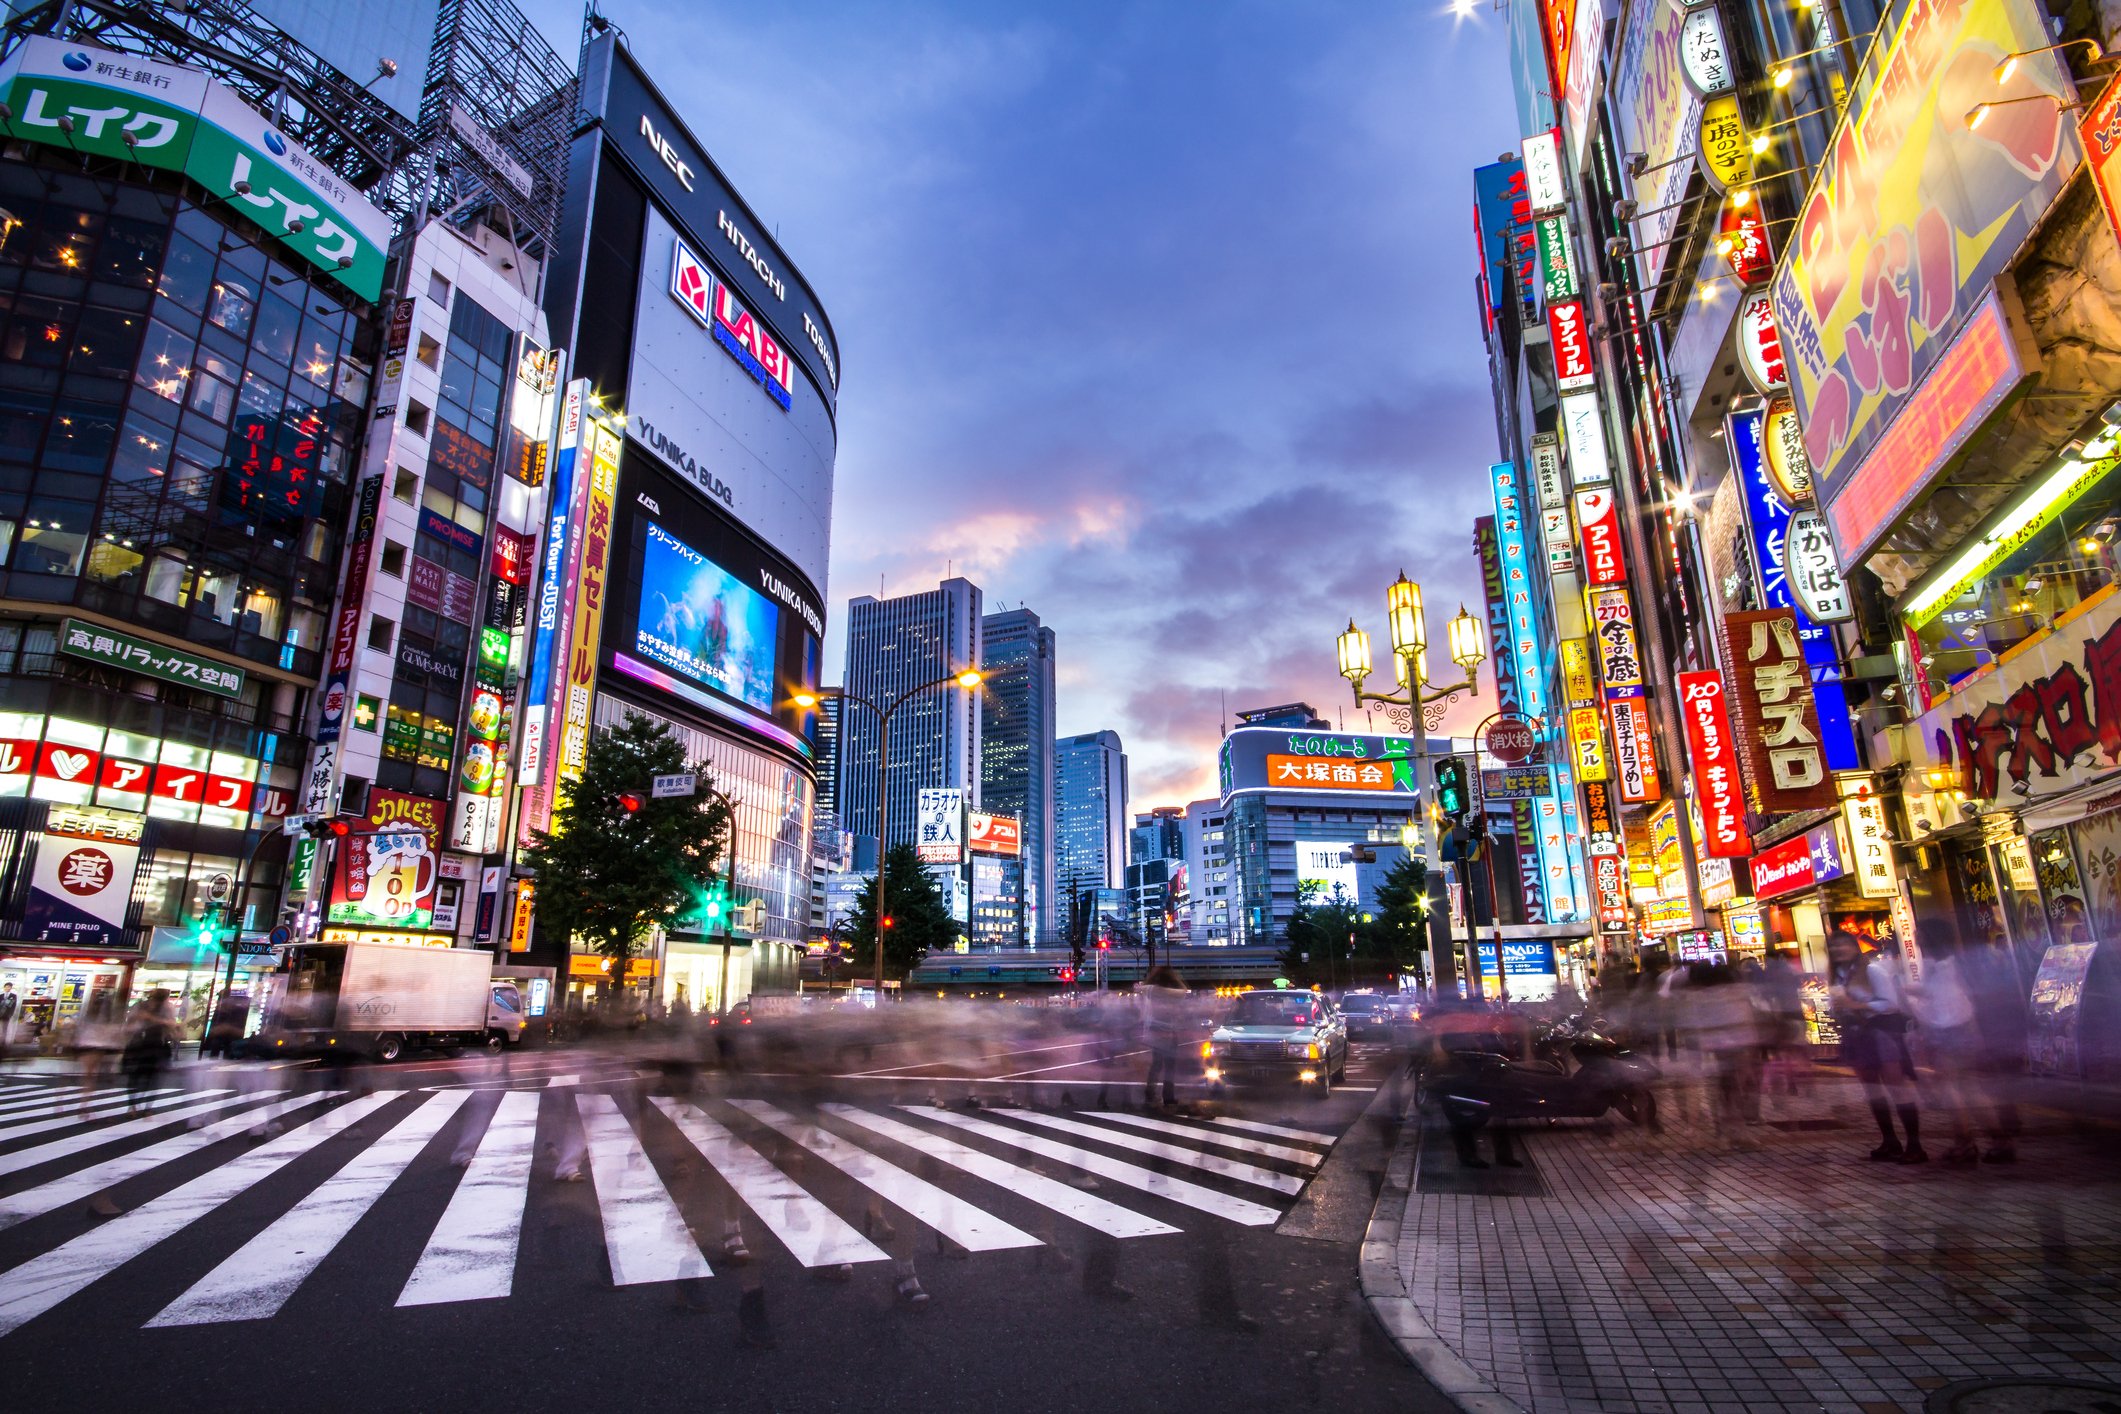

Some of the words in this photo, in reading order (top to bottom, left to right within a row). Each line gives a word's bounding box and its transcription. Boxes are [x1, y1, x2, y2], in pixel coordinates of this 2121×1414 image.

[1695, 30, 1724, 81] たぬき
[96, 60, 172, 91] 新生銀行
[1709, 80, 1726, 92] 5F
[22, 89, 180, 149] レイク
[640, 114, 695, 193] NEC
[1708, 122, 1745, 168] 虎の子
[289, 151, 348, 205] 新生銀行
[1728, 170, 1750, 183] 4F
[229, 151, 359, 263] レイク
[718, 208, 785, 302] HITACHI
[715, 281, 794, 396] LABI
[802, 311, 836, 391] TOSHIBA
[1558, 320, 1585, 378] アイフル
[567, 404, 579, 434] LABI
[435, 450, 489, 489] マッサージ
[637, 415, 698, 479] YUNIKA
[699, 466, 735, 509] BLDG.
[636, 491, 661, 516] LISA
[428, 516, 476, 550] PROMISE
[497, 534, 519, 552] FAST
[648, 524, 703, 567] クリープハイプ
[1590, 525, 1615, 570] アコム
[416, 565, 440, 581] FAST
[496, 545, 517, 563] NAIL
[1480, 524, 1504, 599] パチンコ
[1802, 531, 1841, 593] かっぱ
[415, 575, 438, 591] NAIL
[572, 493, 609, 685] 決算セール
[1598, 571, 1616, 582] 3F
[540, 580, 560, 631] JUST
[760, 567, 802, 615] YUNIKA
[801, 599, 824, 639] VISION
[1597, 607, 1629, 622] 270
[1818, 598, 1843, 613] B1
[336, 608, 358, 669] アイフル
[1489, 600, 1519, 708] エスパス
[1600, 620, 1639, 682] 金の蔵
[1799, 629, 1824, 640] 3F
[67, 629, 240, 692] 高興リラックス空間
[324, 691, 345, 712] 薬
[1617, 688, 1635, 698] 2F
[1747, 616, 1824, 790] パチスロ
[1490, 731, 1531, 750] 消火栓
[1575, 710, 1601, 766] 麻雀ブル
[1685, 681, 1722, 761] 100円ショップ
[528, 736, 540, 770] LABI
[1288, 734, 1368, 758] たのめーる
[1612, 702, 1642, 796] 東京チカラめし
[1636, 731, 1655, 777] 焼き牛丼
[112, 760, 287, 817] アイフル
[306, 745, 334, 811] 大勝軒
[656, 776, 693, 790] 歌舞伎町
[1277, 762, 1384, 784] 大塚商会
[1504, 775, 1549, 791] セキネ
[1586, 768, 1600, 779] 6F
[921, 791, 960, 812] カラオケ
[935, 811, 945, 825] の
[1587, 783, 1610, 832] お好み焼
[370, 797, 444, 849] カルビちゃん
[460, 801, 477, 846] 日高屋
[923, 823, 956, 842] 鉄人
[992, 824, 1017, 838] アコム
[1857, 805, 1888, 878] 養老乃瀧
[298, 843, 316, 884] レイク
[374, 833, 422, 856] 生ビール
[990, 842, 999, 850] 2F
[1595, 843, 1612, 853] 8F
[62, 853, 108, 890] 薬
[1521, 853, 1547, 925] エスパス
[1598, 859, 1621, 909] 居酒屋
[48, 920, 72, 931] MINE
[74, 921, 101, 932] DRUG
[1607, 920, 1623, 931] 4F
[226, 942, 273, 955] PNDORA
[1477, 944, 1545, 957] SUNADE
[534, 981, 544, 995] P
